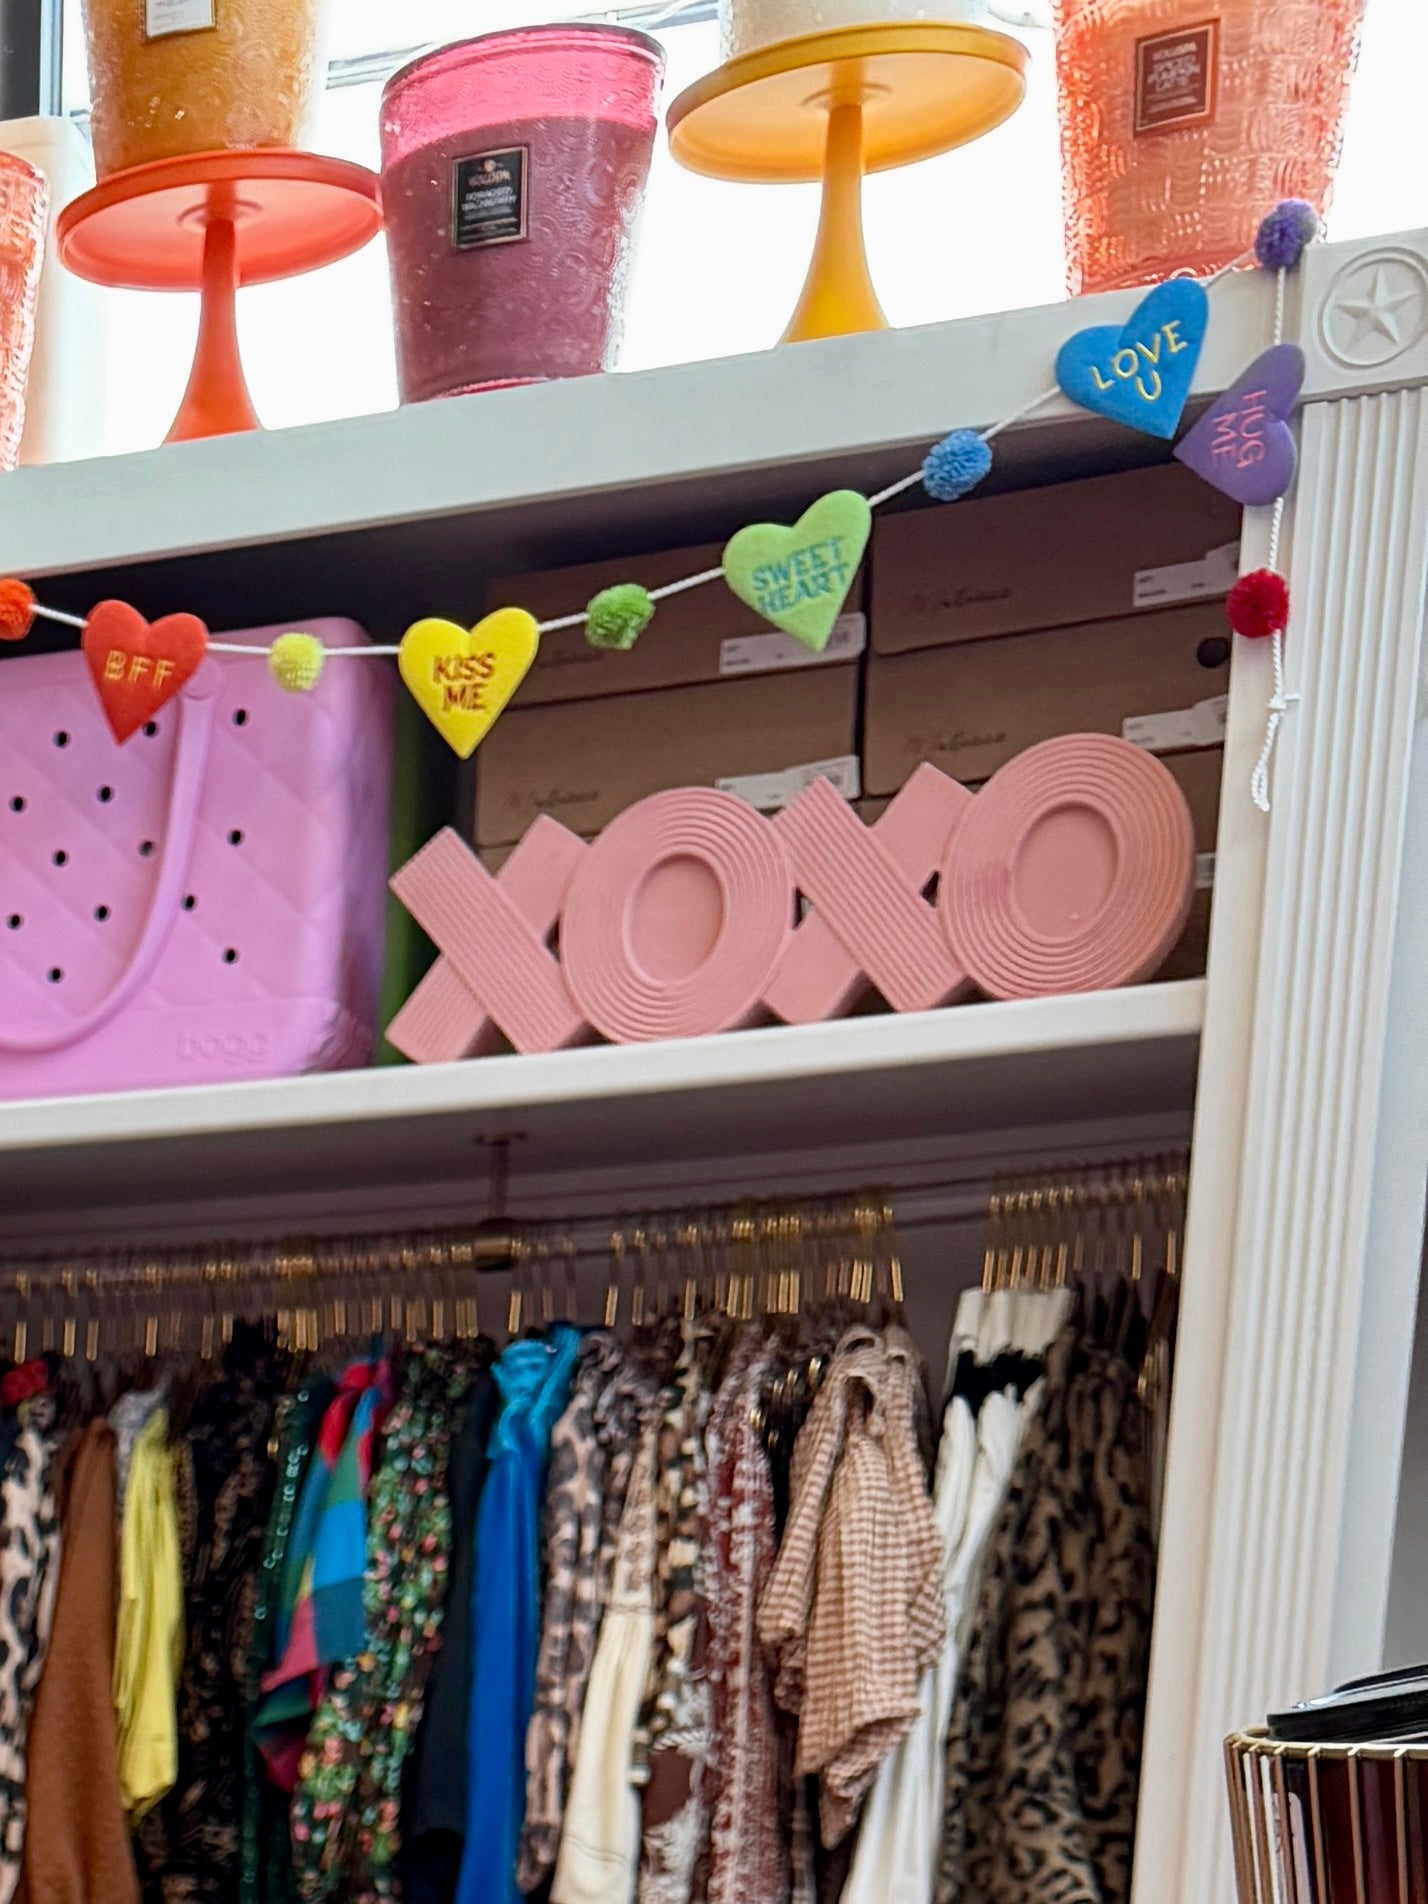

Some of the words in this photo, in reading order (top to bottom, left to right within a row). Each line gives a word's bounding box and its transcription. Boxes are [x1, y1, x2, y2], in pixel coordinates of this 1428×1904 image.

[1091, 319, 1188, 392] LOVE
[1135, 370, 1162, 401] U
[1210, 411, 1236, 463] ME
[1236, 389, 1268, 469] HUG
[751, 534, 848, 598] SWEET
[755, 561, 852, 617] HEART
[103, 649, 176, 690] BFF
[432, 651, 496, 685] KISS
[442, 682, 488, 713] ME
[386, 731, 1195, 1065] XOXO
